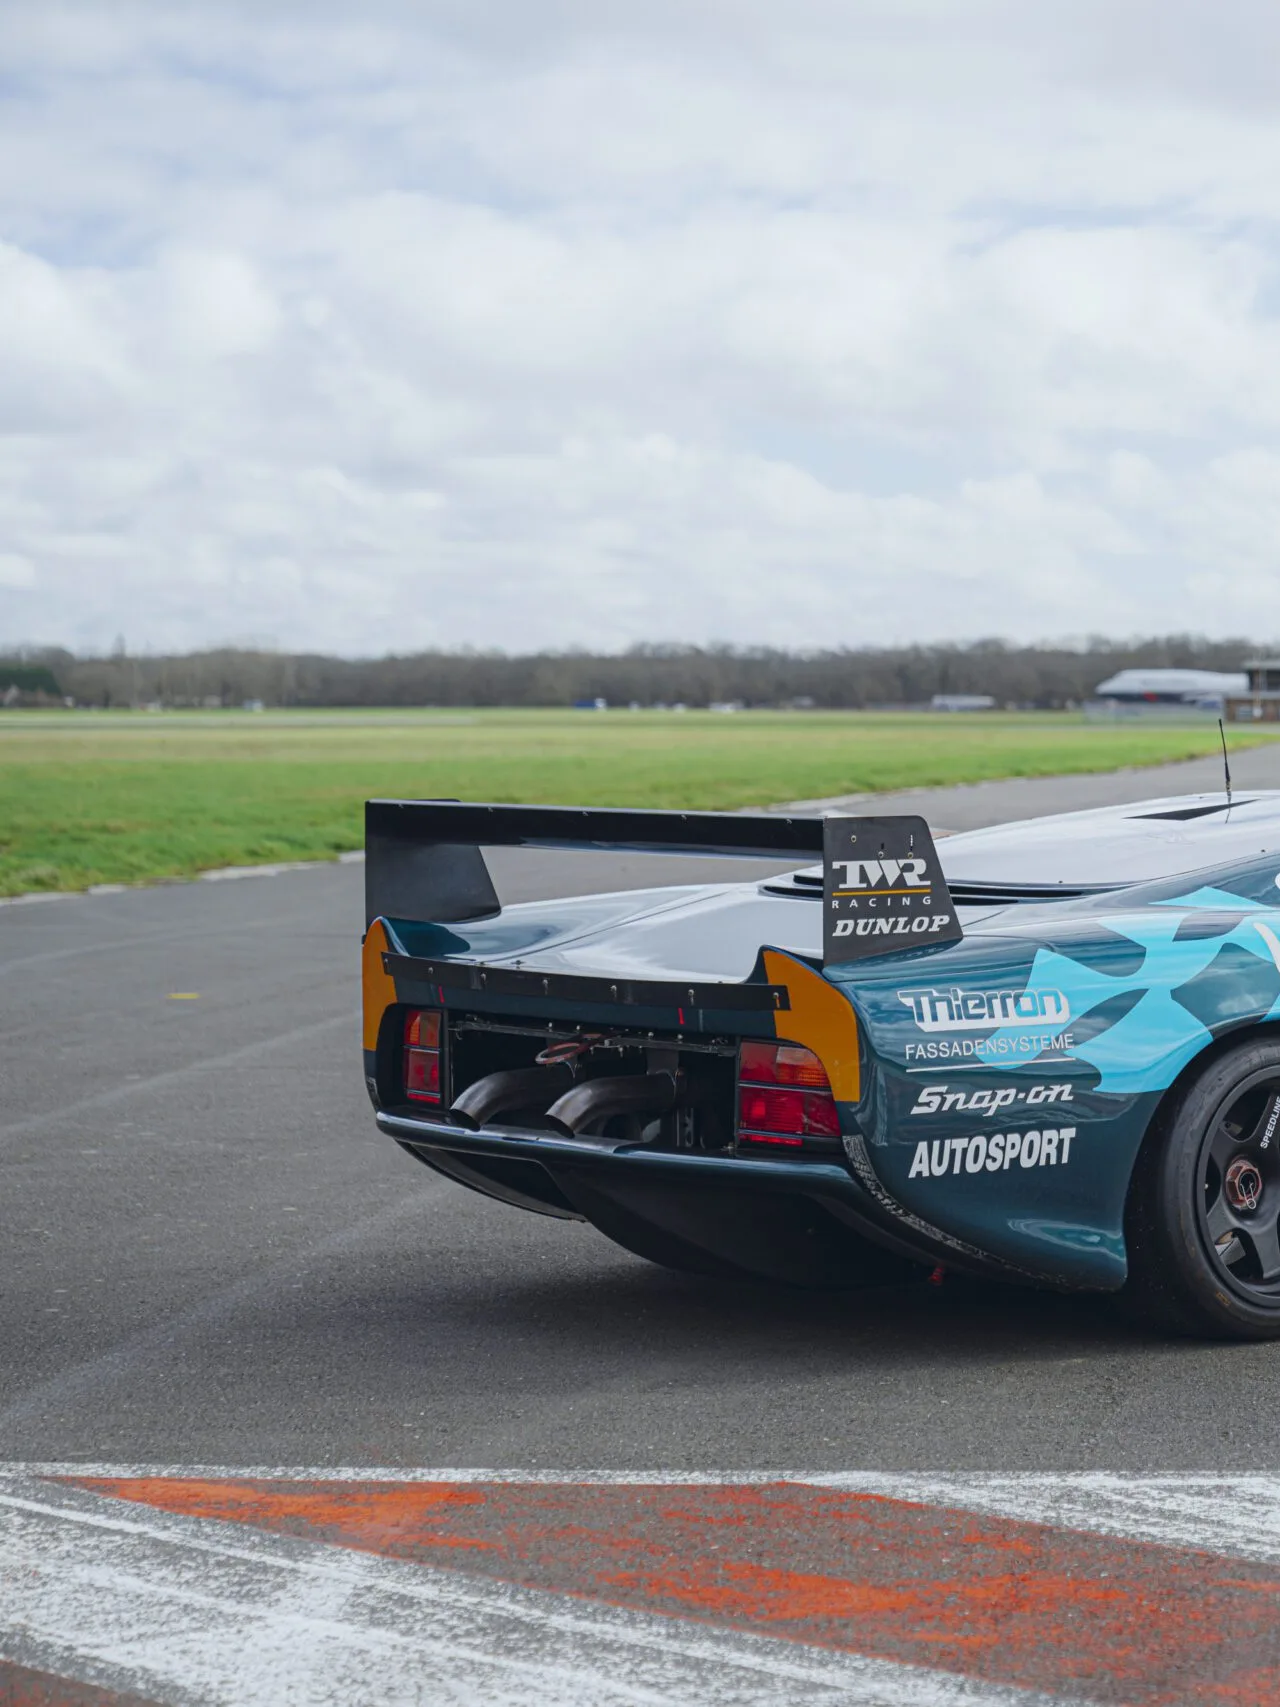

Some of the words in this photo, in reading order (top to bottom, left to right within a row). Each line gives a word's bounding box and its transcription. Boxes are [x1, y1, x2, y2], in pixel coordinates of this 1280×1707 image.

[832, 858, 931, 889] TWR
[832, 896, 931, 909] RACING
[832, 915, 950, 937] DUNLOP
[897, 988, 1070, 1032] Thierron
[905, 1033, 1076, 1060] FASSADENSYSTEME
[910, 1083, 1074, 1117] Snap-on
[908, 1127, 1077, 1178] AUTOSPORT
